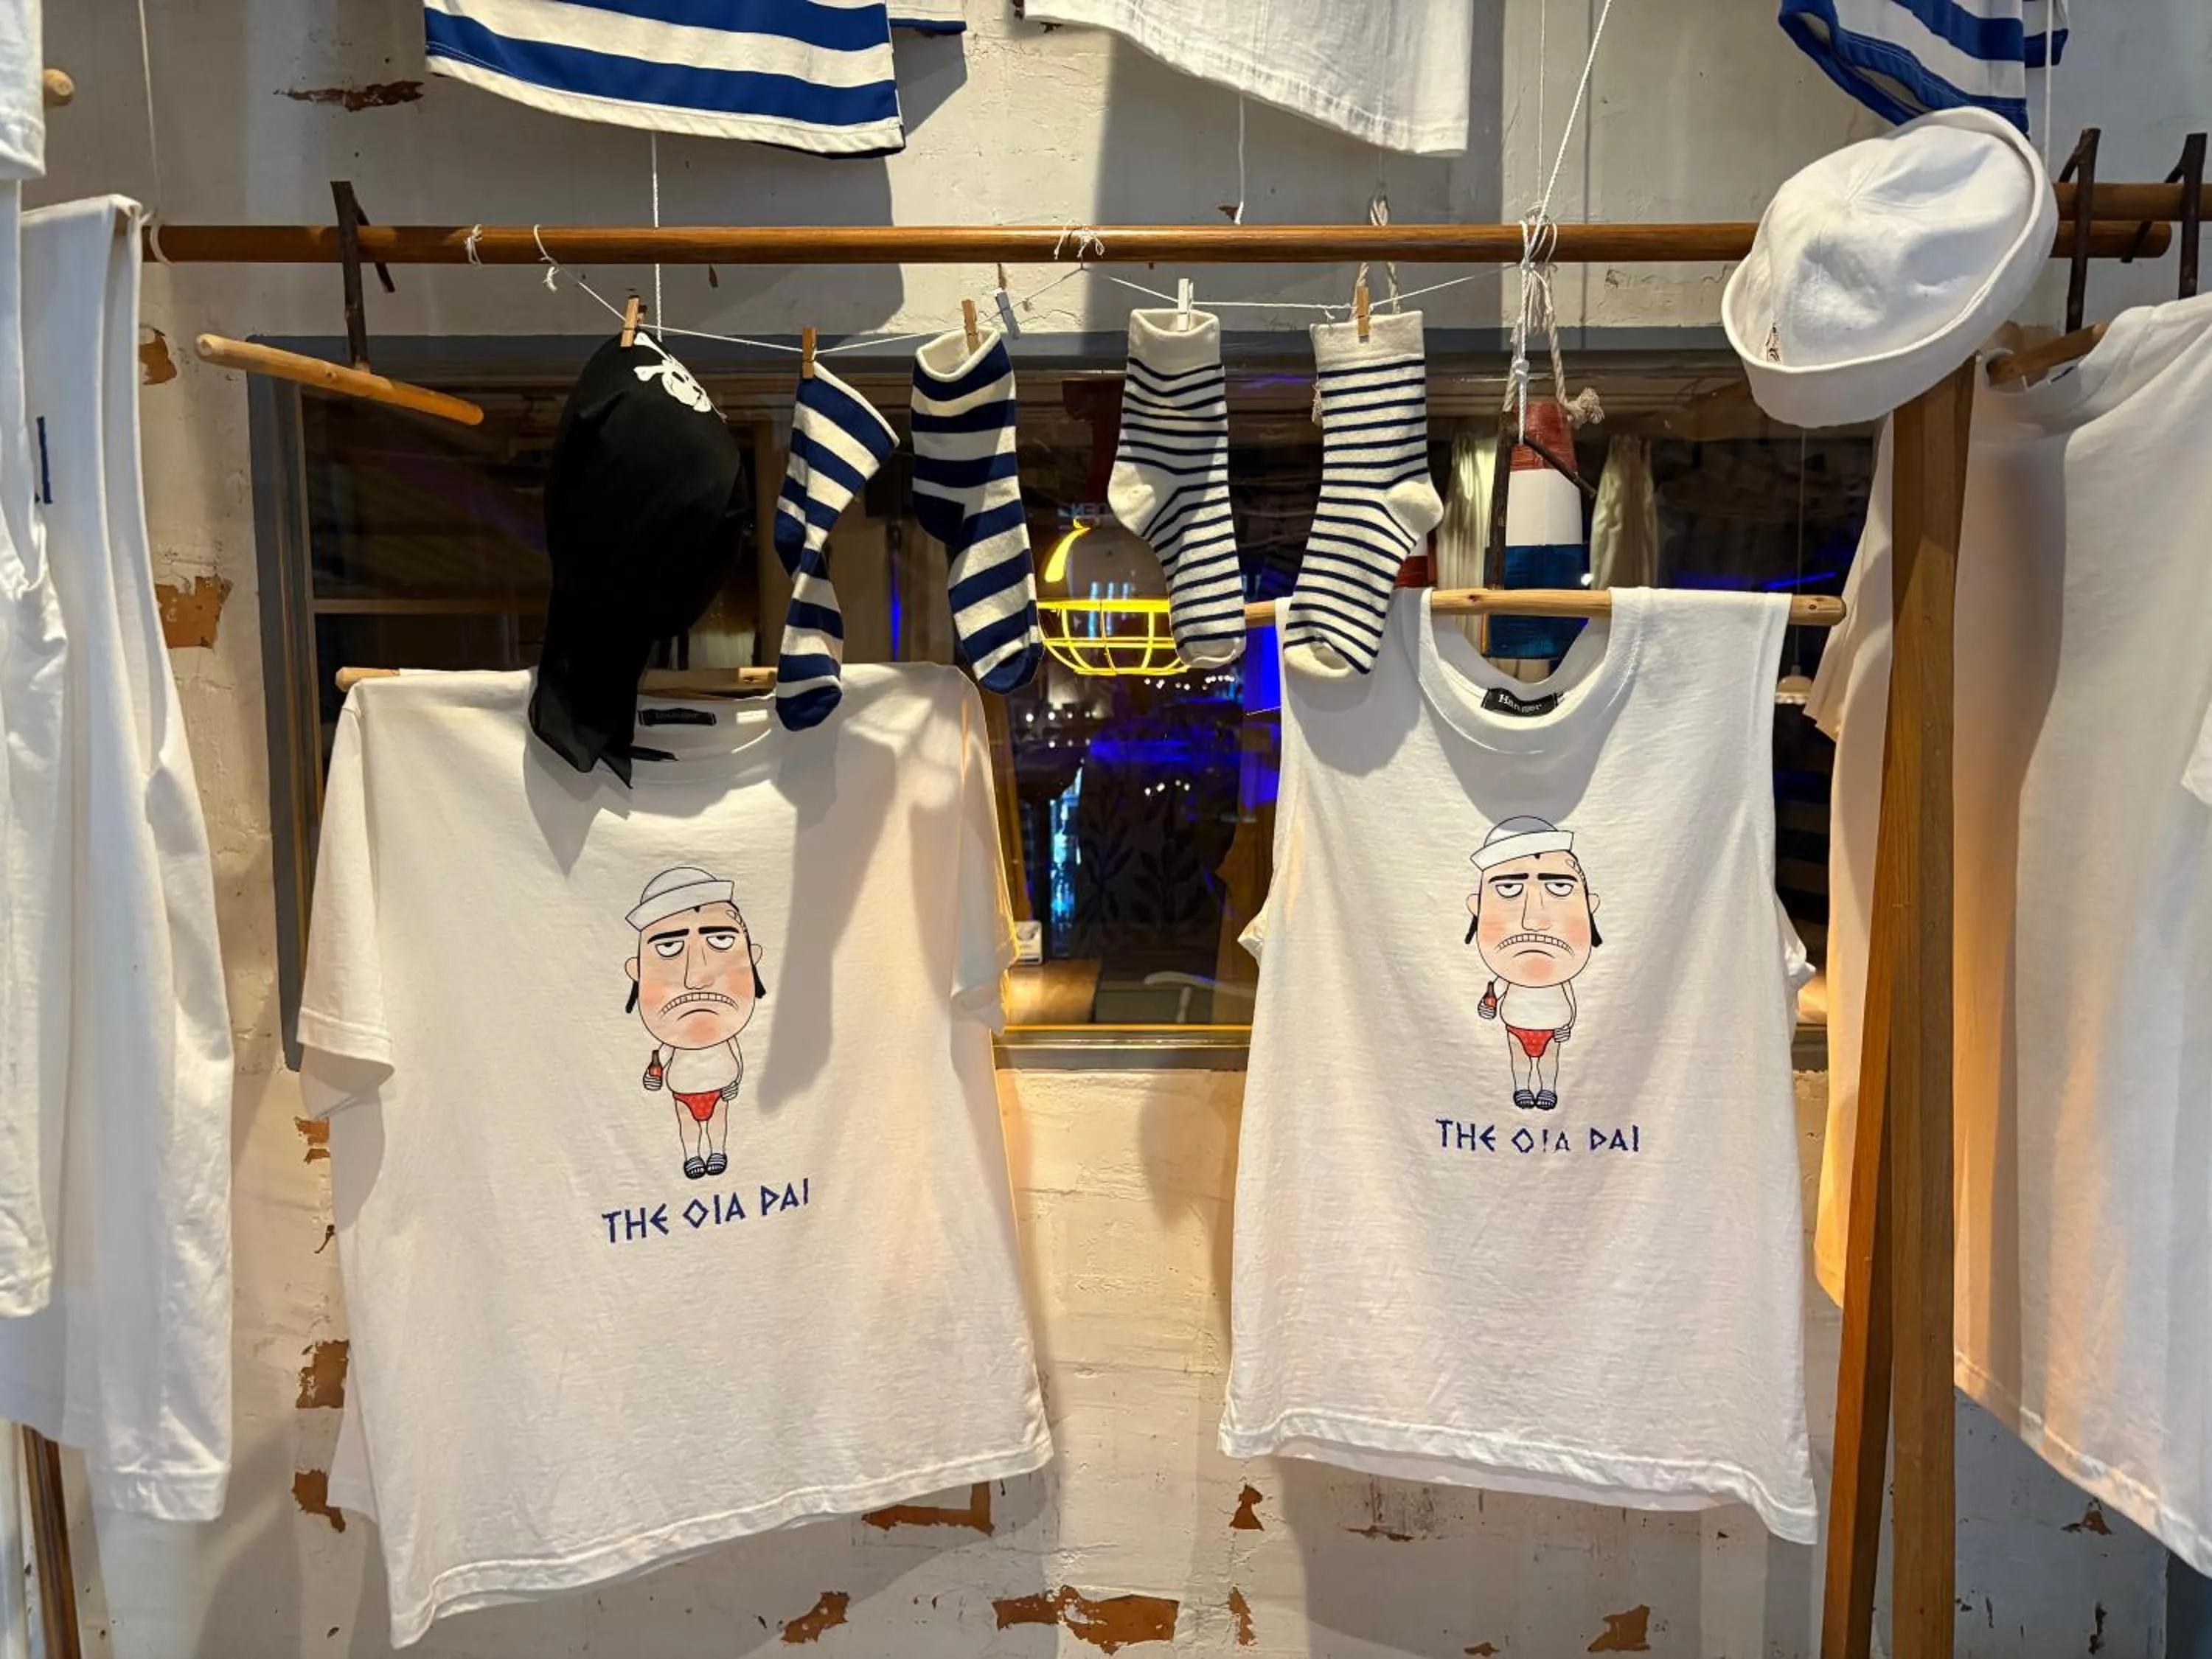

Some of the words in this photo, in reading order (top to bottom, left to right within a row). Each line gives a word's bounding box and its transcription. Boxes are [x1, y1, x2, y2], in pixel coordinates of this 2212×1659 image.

[1436, 1119, 1496, 1152] THE
[1512, 1127, 1571, 1153] OIA
[602, 1203, 669, 1243] THE
[683, 1192, 746, 1228] OIA
[760, 1178, 809, 1216] PAI
